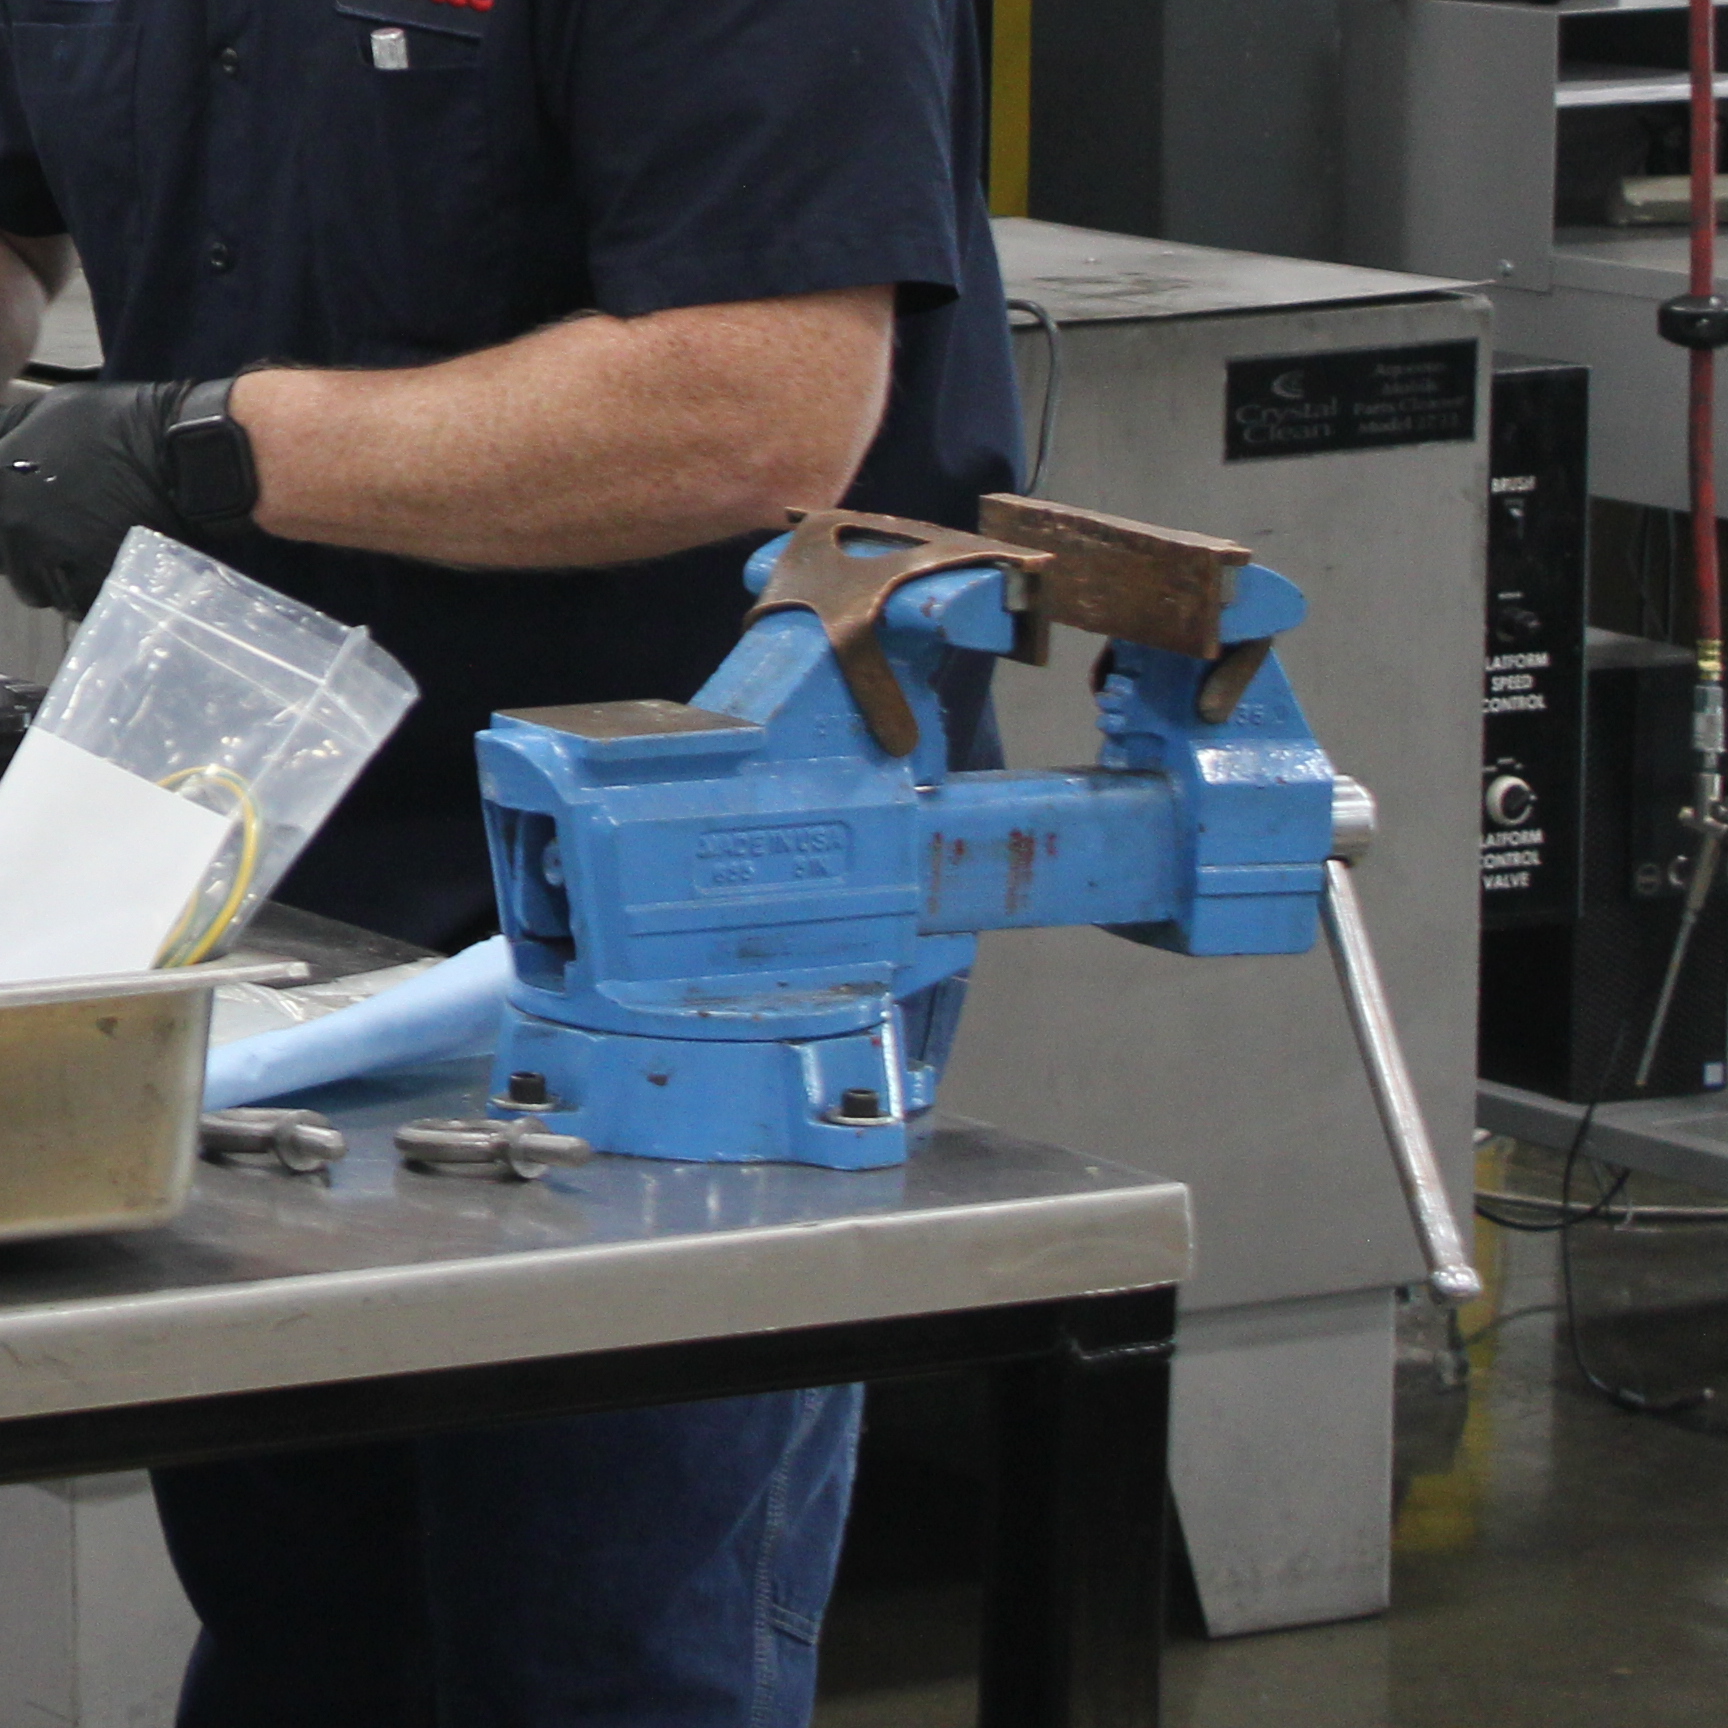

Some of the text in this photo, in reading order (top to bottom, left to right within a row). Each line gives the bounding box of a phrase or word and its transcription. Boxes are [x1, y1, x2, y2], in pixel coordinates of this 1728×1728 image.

[1235, 396, 1339, 428] Crystal
[1243, 423, 1332, 444] Clean
[1490, 476, 1537, 493] BRUSH
[1491, 674, 1534, 691] SPEED
[1483, 872, 1530, 890] VALVE
